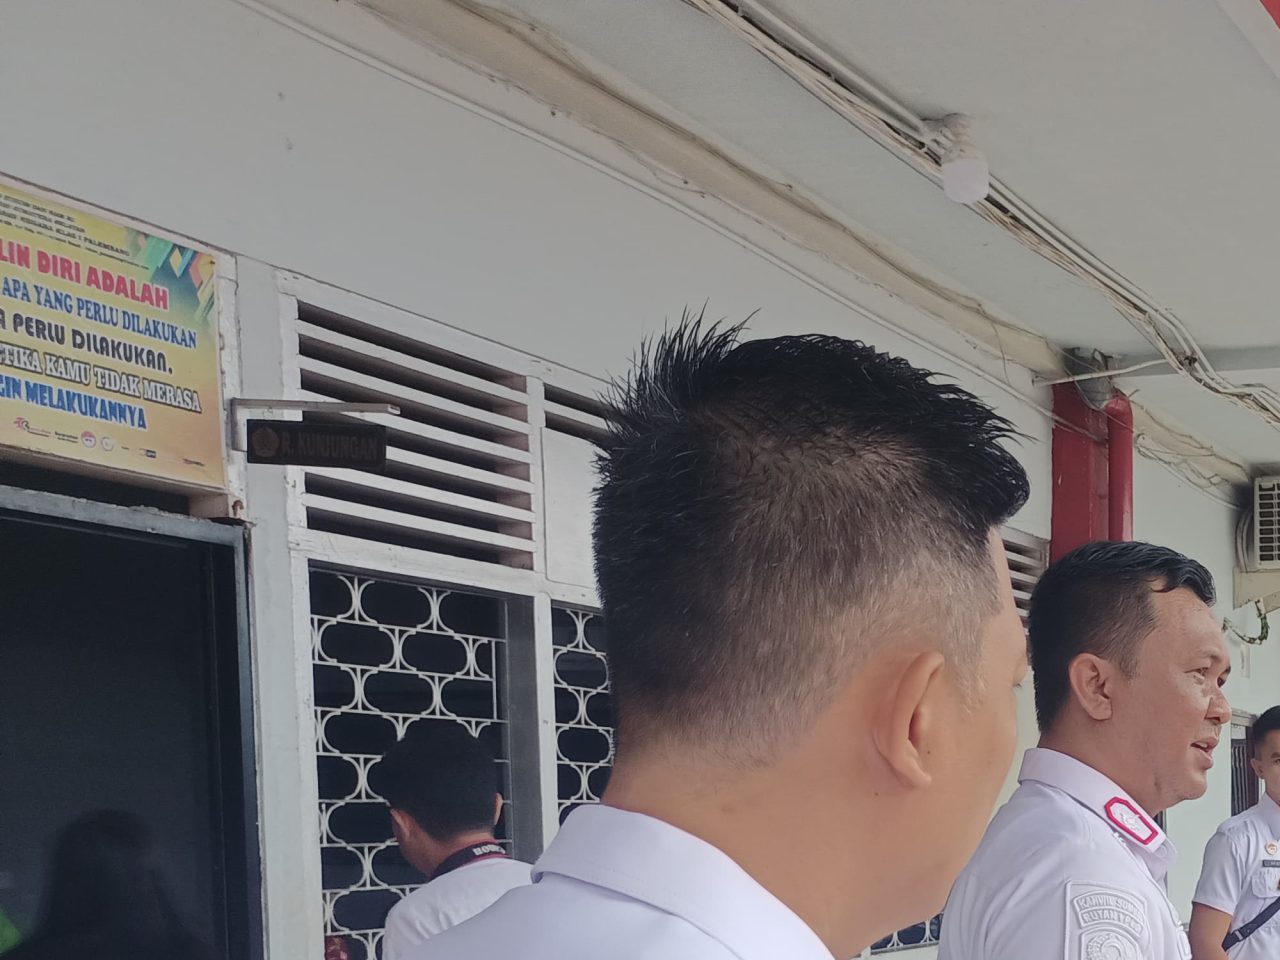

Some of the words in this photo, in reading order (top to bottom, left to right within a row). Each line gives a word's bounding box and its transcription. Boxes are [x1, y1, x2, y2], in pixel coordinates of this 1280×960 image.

[37, 251, 81, 284] DIRI
[86, 266, 168, 310] ADALAH
[3, 276, 32, 304] APA
[33, 284, 73, 314] YANG
[76, 297, 119, 327] PERLU
[122, 310, 197, 349] DILAKUKAN
[13, 313, 65, 346] PERLU
[71, 329, 173, 374] DILAKUKAN.
[25, 381, 147, 429] MELAKUKANNYA
[44, 352, 91, 386] KAMU
[93, 365, 141, 399] TIDAK
[143, 378, 202, 414] MERASA
[298, 431, 378, 461] KUNJUNGAN
